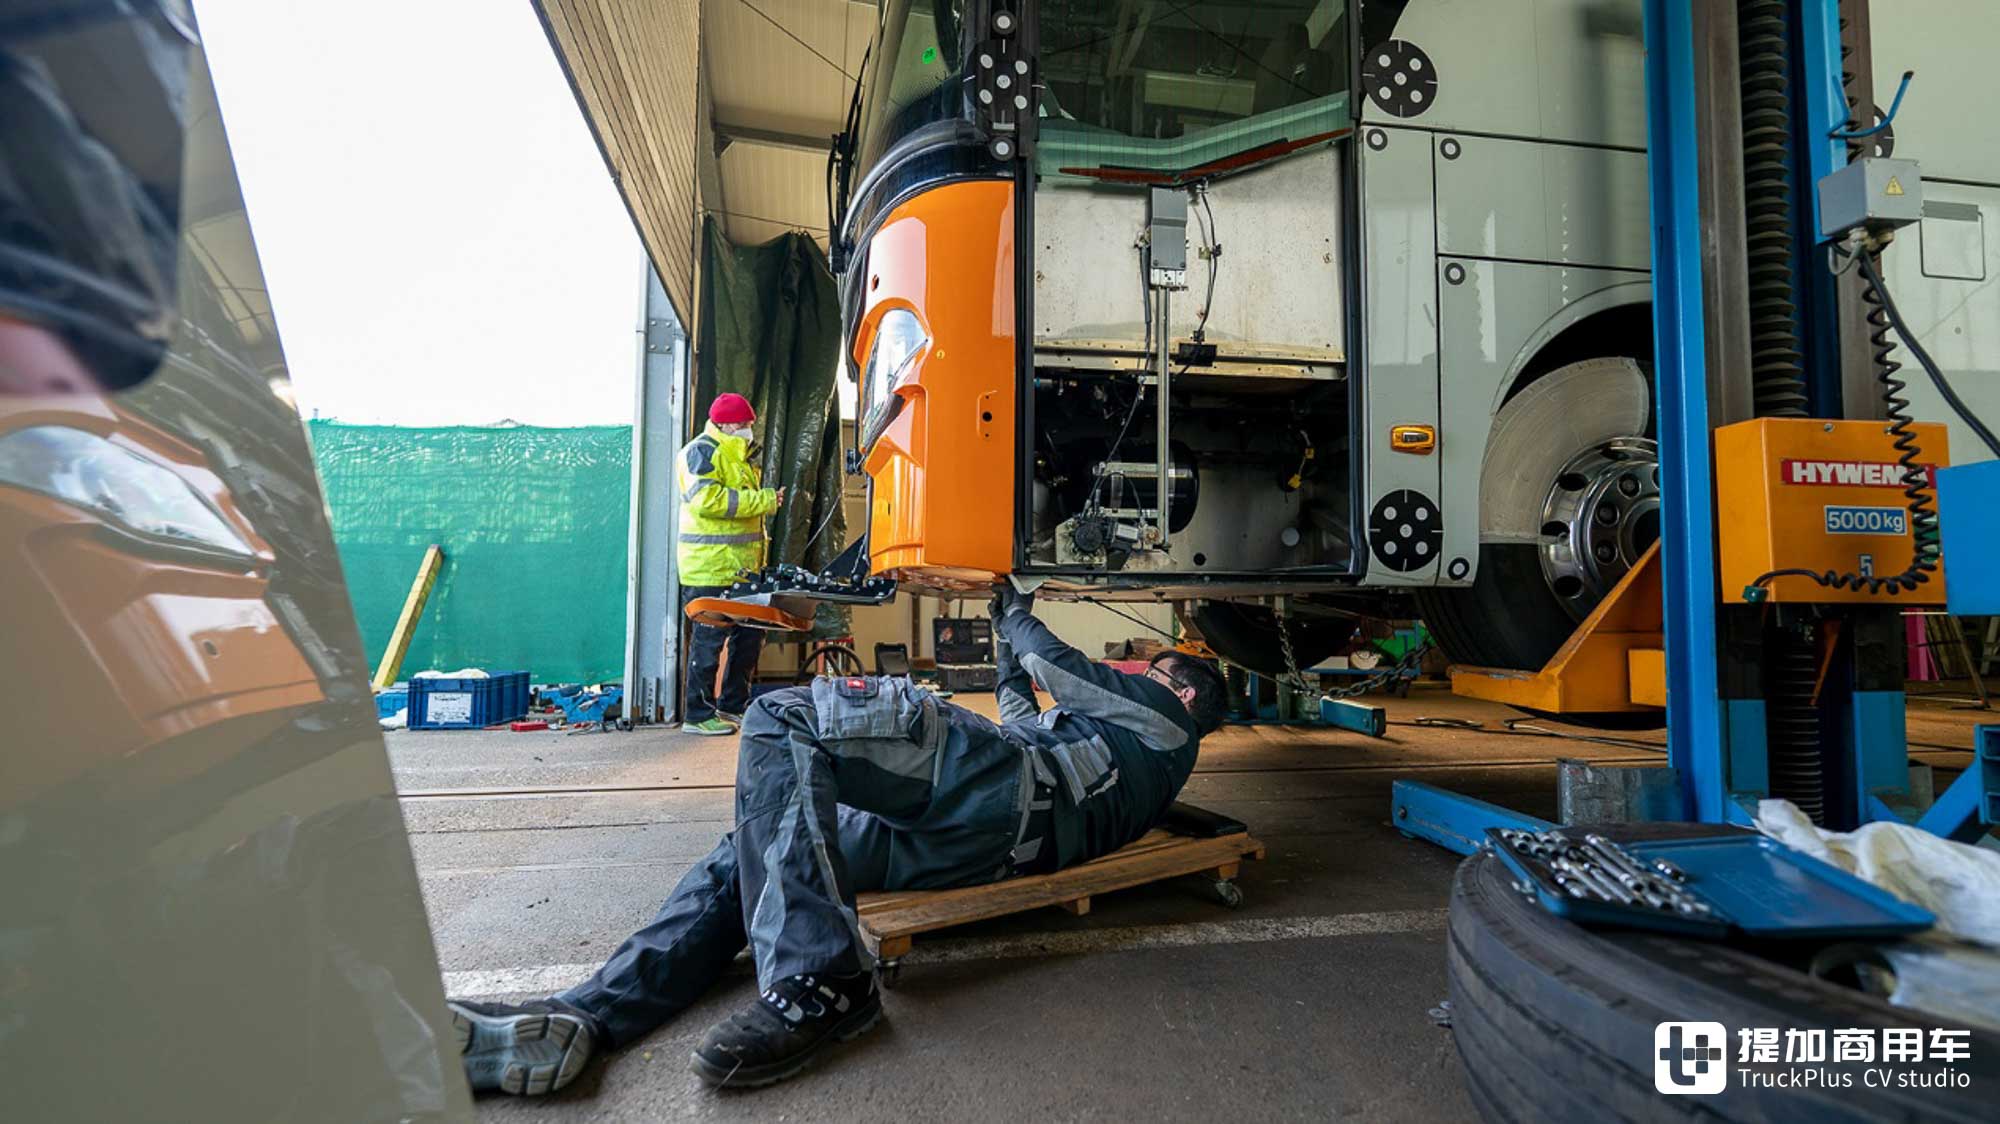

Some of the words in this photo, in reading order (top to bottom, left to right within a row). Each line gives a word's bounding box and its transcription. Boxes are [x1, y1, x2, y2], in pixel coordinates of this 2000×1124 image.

[1827, 511, 1882, 530] 5000
[1883, 512, 1903, 532] kg
[1860, 555, 1873, 577] 5
